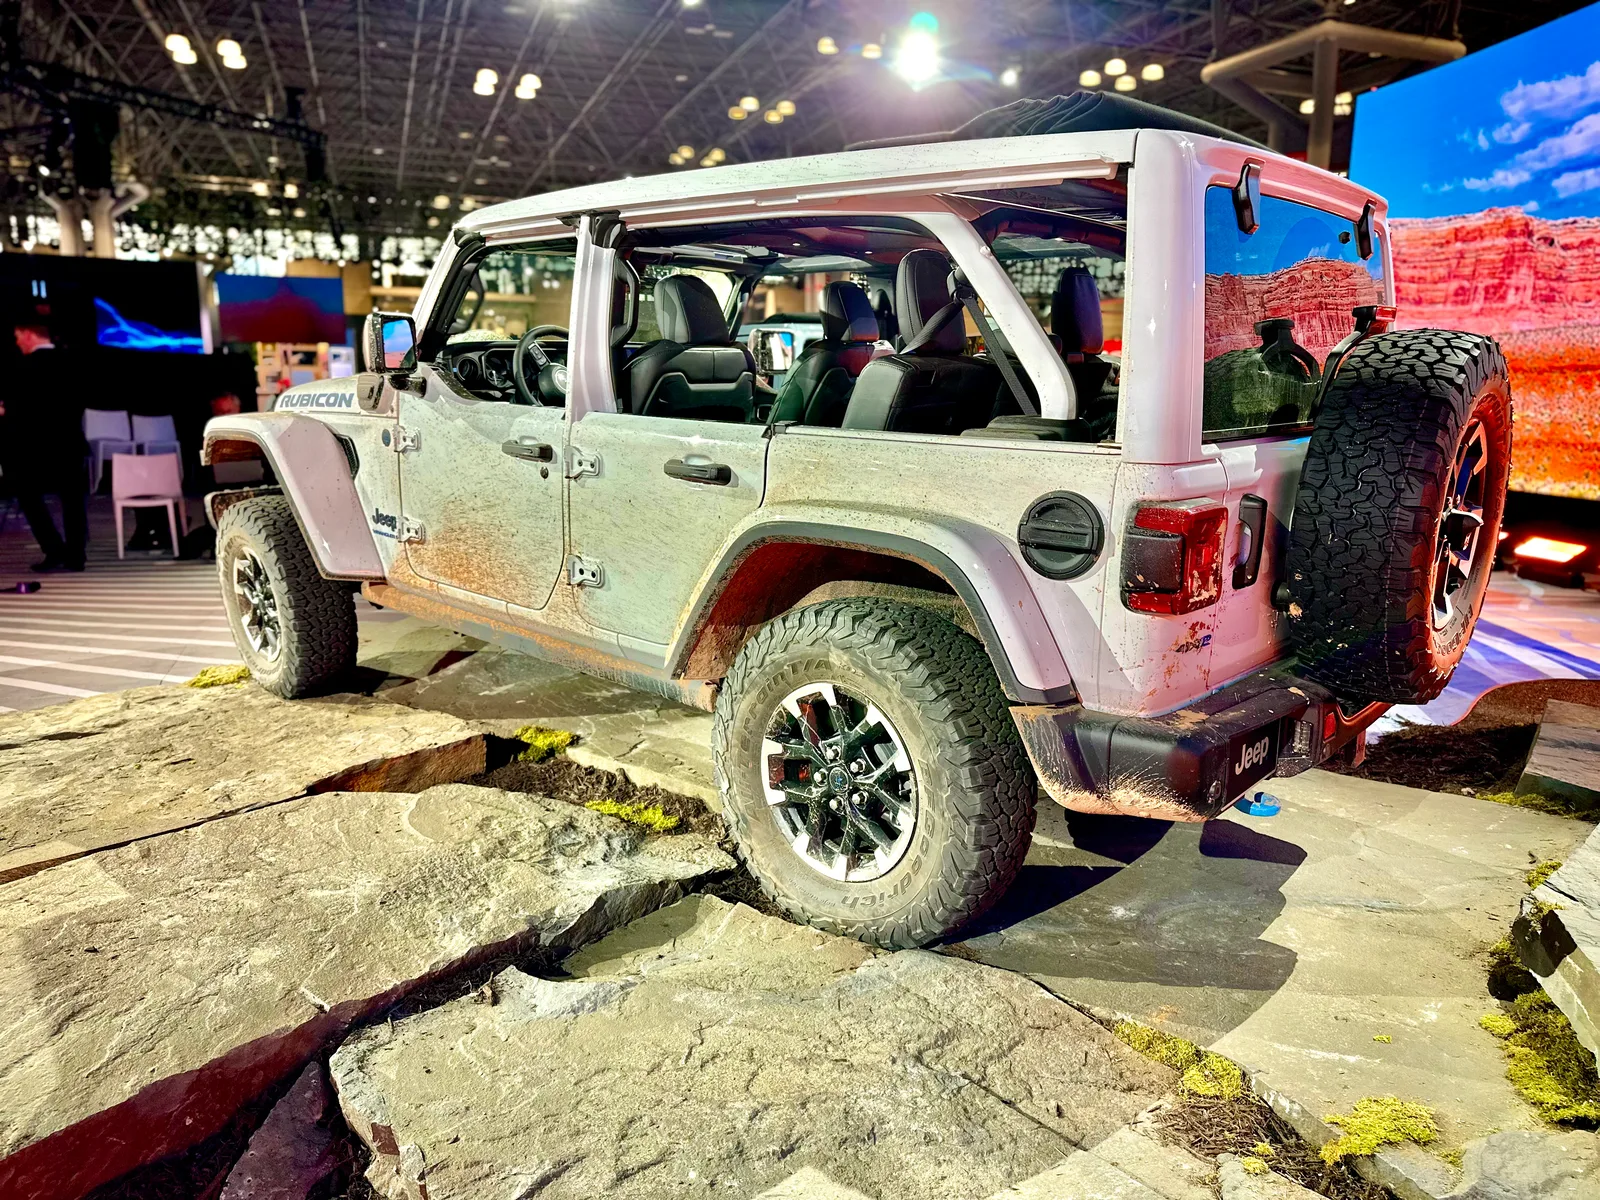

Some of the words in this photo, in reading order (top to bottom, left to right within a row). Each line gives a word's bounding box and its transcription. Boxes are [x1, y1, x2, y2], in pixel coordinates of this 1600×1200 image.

[280, 392, 355, 408] RUBICON
[372, 507, 397, 532] Jeep
[1235, 736, 1269, 775] Jeep
